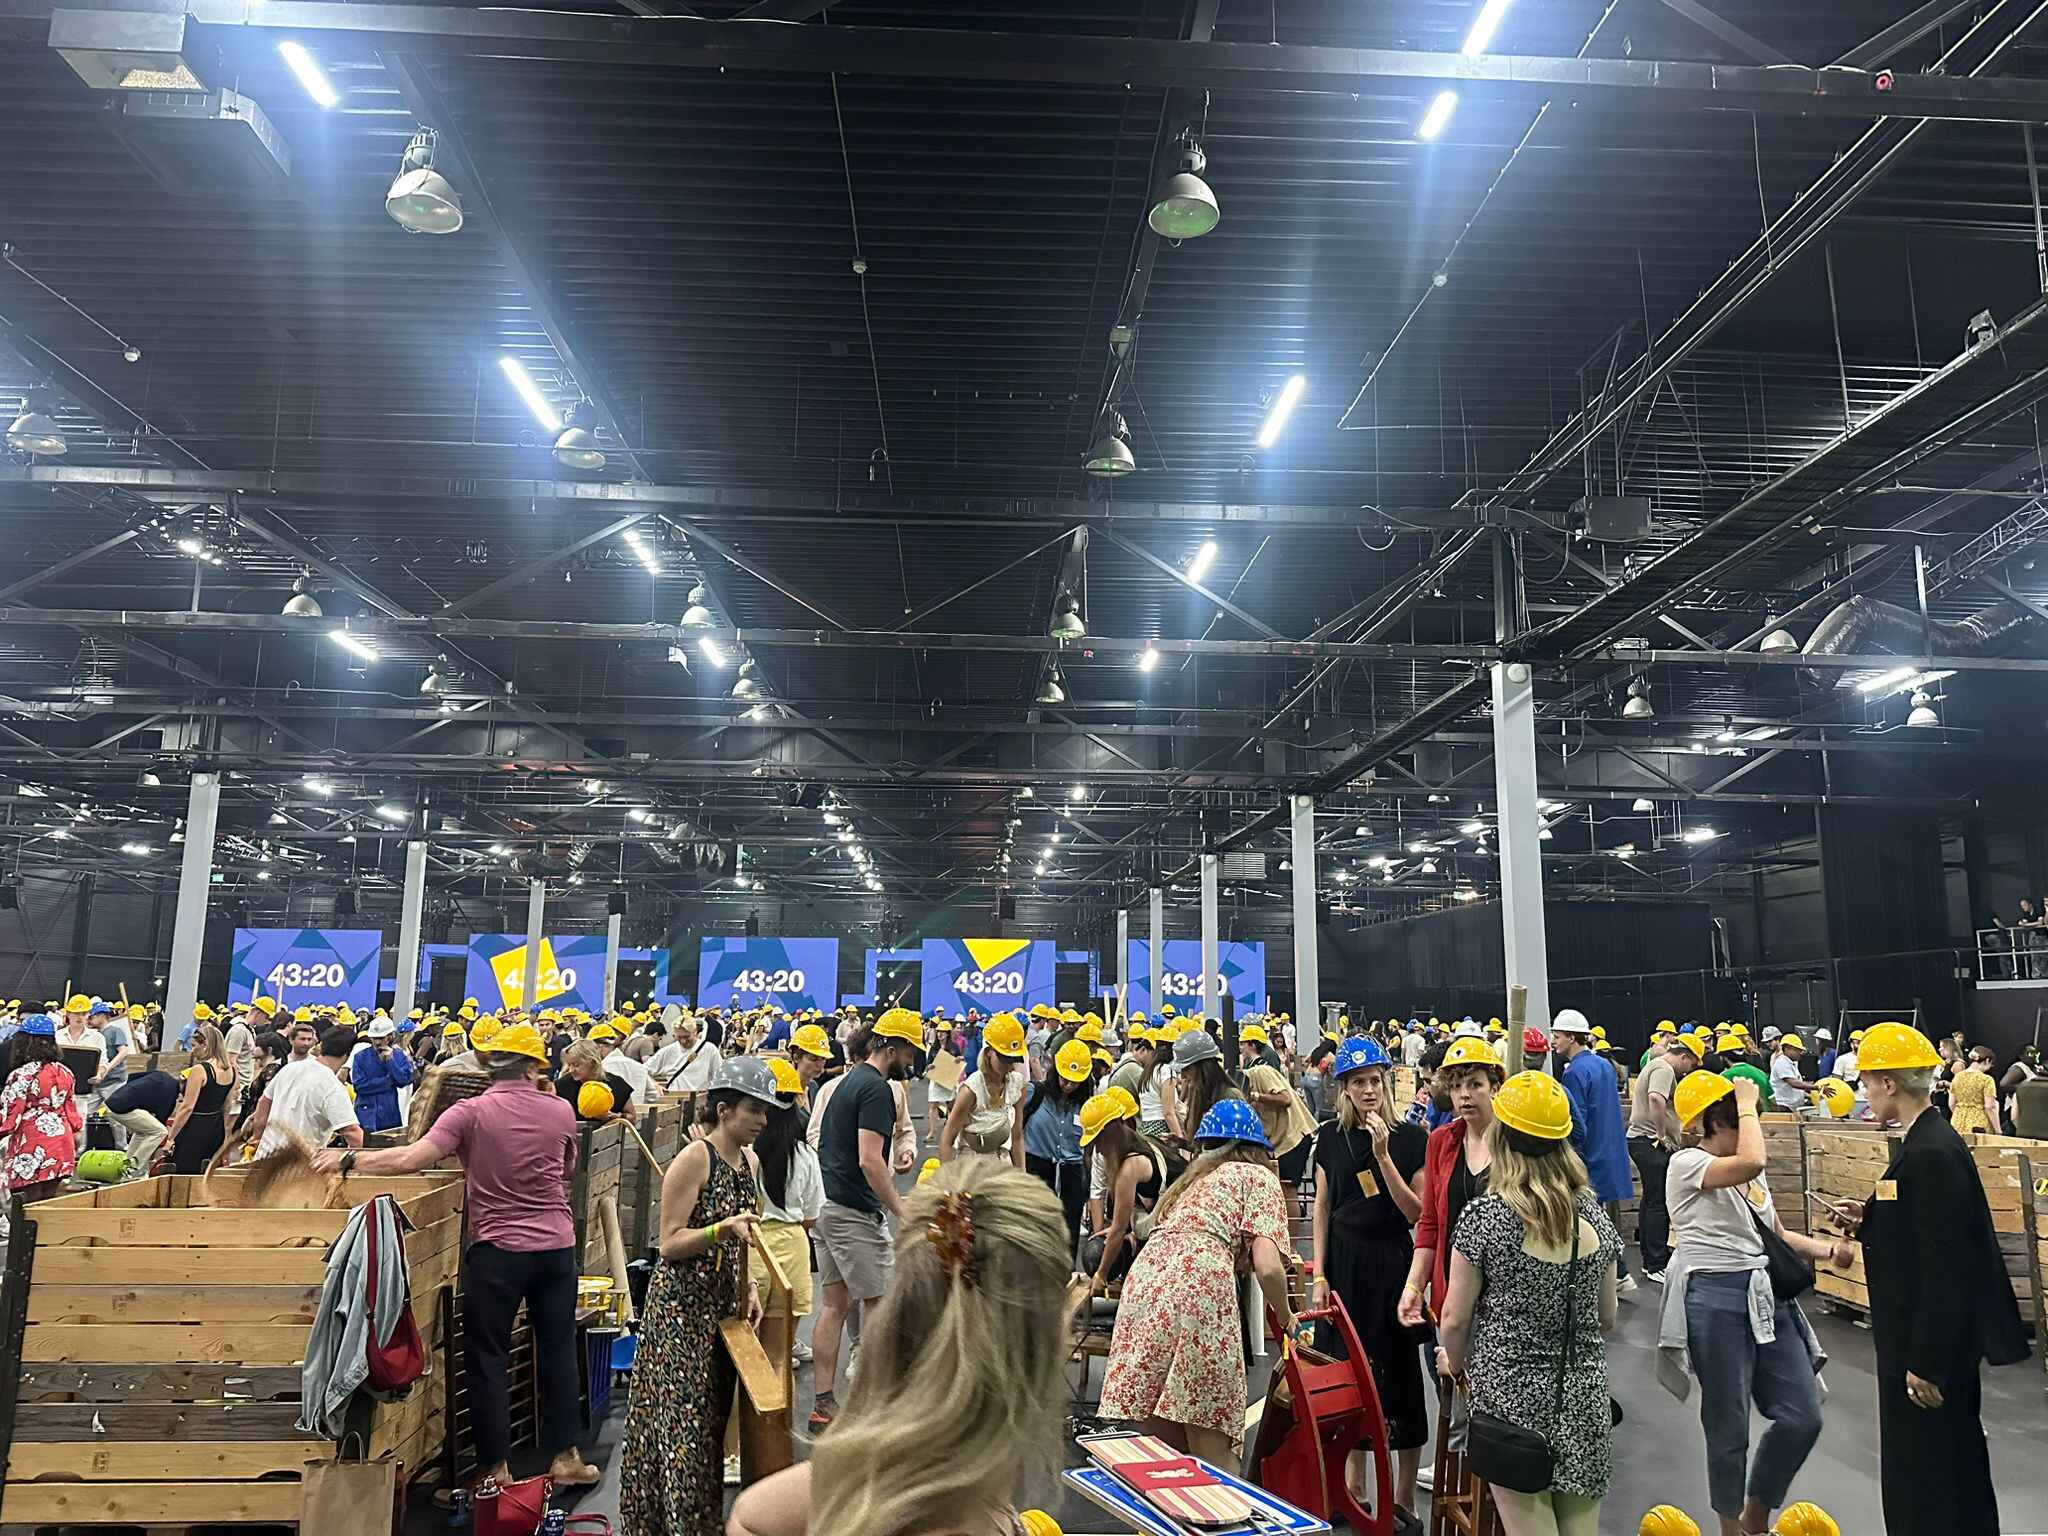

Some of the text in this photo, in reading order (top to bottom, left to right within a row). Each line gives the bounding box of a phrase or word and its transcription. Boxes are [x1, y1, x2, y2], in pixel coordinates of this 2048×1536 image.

[267, 963, 345, 988] 43:20
[733, 969, 805, 993] 43:20
[953, 971, 1024, 994] 43:20
